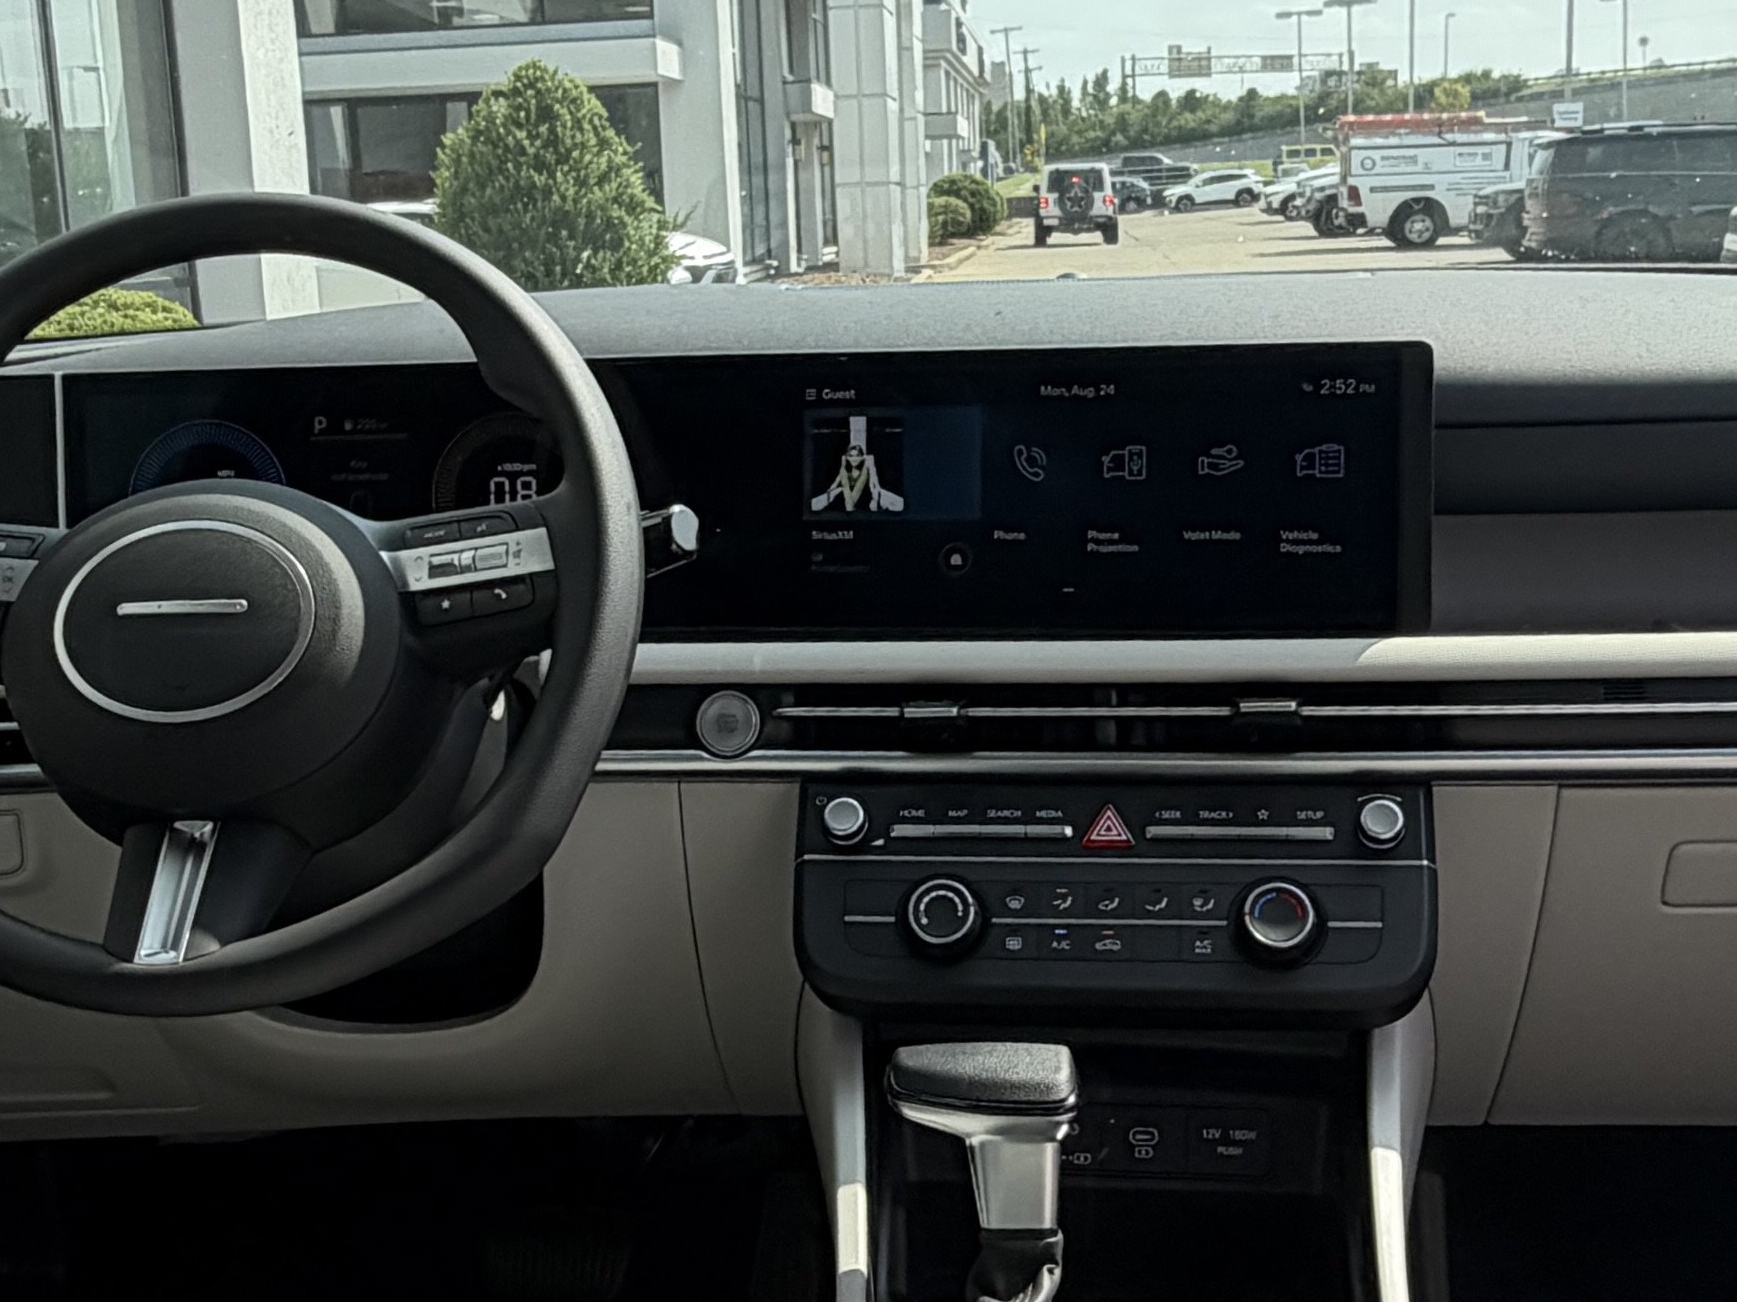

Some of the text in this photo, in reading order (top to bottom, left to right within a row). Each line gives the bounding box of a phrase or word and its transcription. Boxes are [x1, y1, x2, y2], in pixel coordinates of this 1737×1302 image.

[1099, 384, 1115, 396] 24
[1320, 379, 1376, 395] 2:52 PM
[822, 388, 856, 401] Guest
[314, 416, 328, 434] P
[994, 530, 1026, 541] Phone
[1087, 530, 1120, 541] Phone
[1280, 530, 1319, 541] Vehicle
[1279, 543, 1343, 555] Diagnostics
[900, 808, 926, 818] HOME
[948, 809, 969, 818] MAP
[986, 809, 1022, 818] SEARCH
[1035, 808, 1064, 818] MEDIA
[1198, 810, 1229, 819] TRACK
[1296, 810, 1325, 820] SETUP
[1051, 940, 1071, 950] A/C
[1194, 939, 1213, 949] A/C
[1202, 1128, 1222, 1139] 12V
